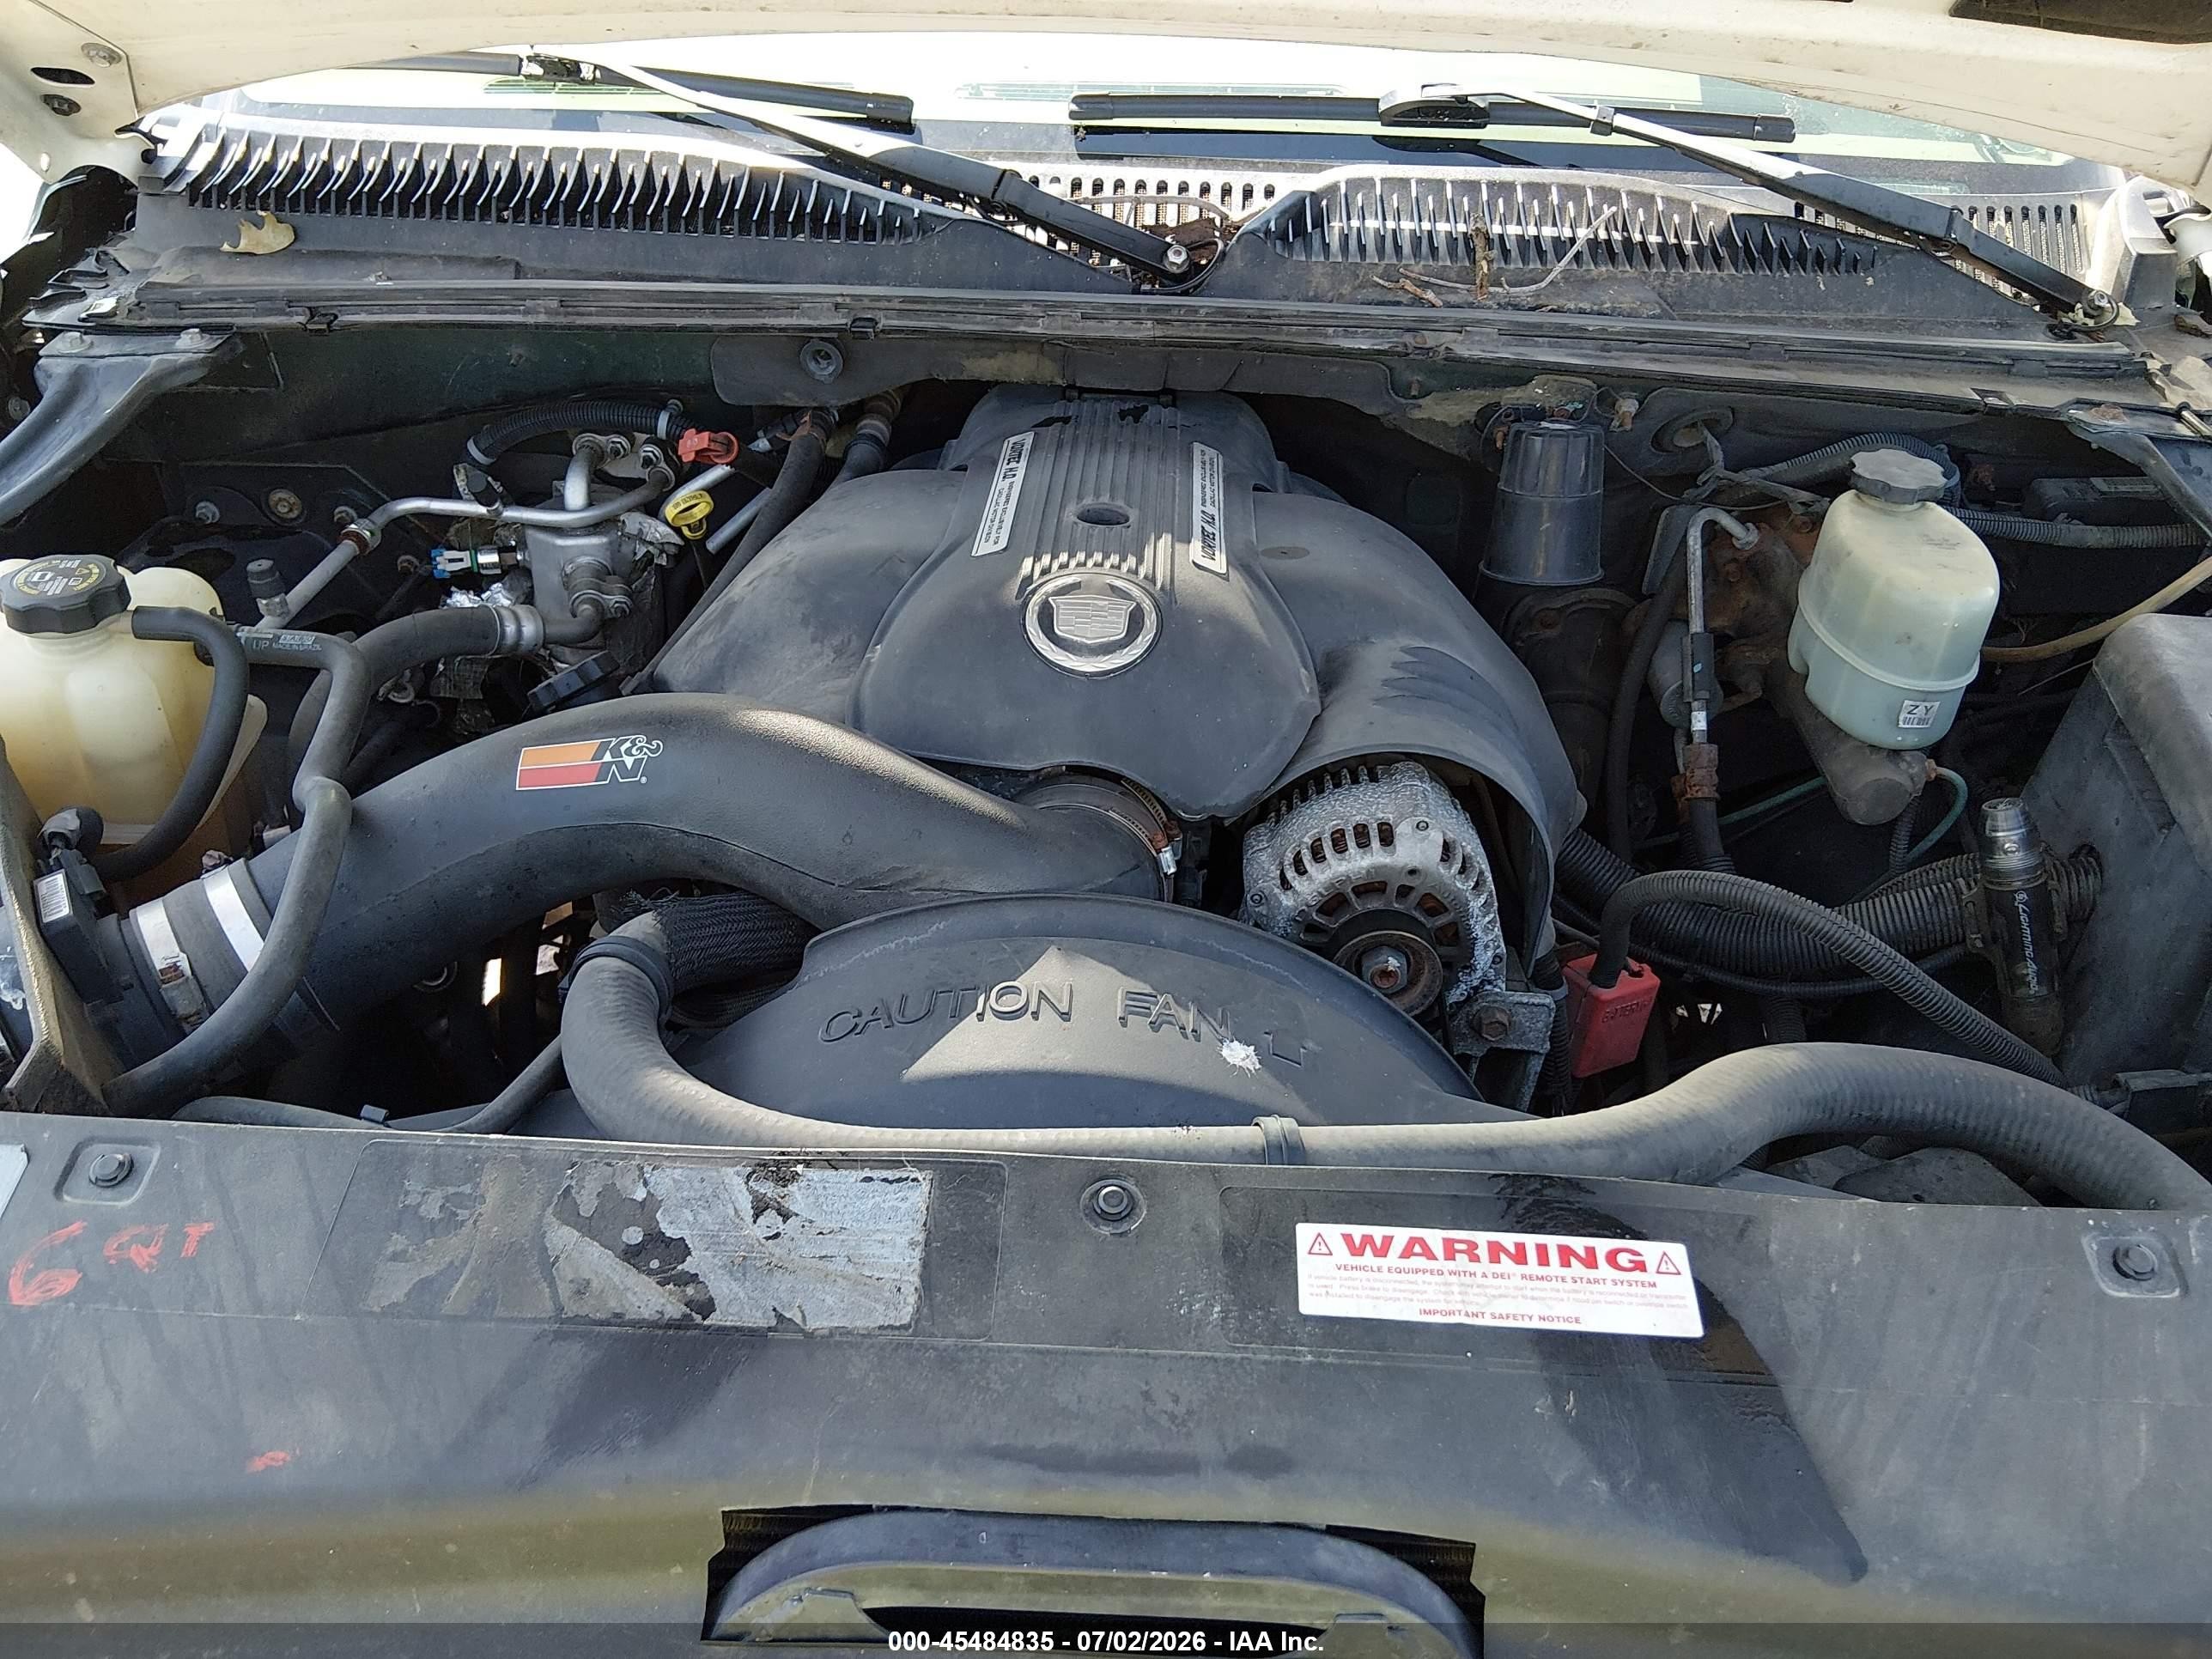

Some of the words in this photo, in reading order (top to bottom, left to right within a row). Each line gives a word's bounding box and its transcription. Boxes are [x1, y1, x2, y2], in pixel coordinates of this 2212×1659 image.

[1007, 439, 1026, 465] VORTEC
[1200, 525, 1217, 561] VORTEC
[820, 981, 1073, 1042] CAUTION
[1118, 986, 1234, 1043] FAN
[1340, 1233, 1648, 1272] WARNING
[1335, 1264, 1383, 1273] VEHICLE
[1388, 1267, 1444, 1277] EQUIPPED
[1448, 1269, 1476, 1279] WITH
[1521, 1273, 1567, 1283] REMOTE
[1571, 1276, 1607, 1285] START
[1611, 1278, 1657, 1288] SYSTEM
[1419, 1309, 1486, 1320] IMPORTANT
[1490, 1312, 1534, 1322] SAFETY
[1538, 1315, 1581, 1324] NOTICE
